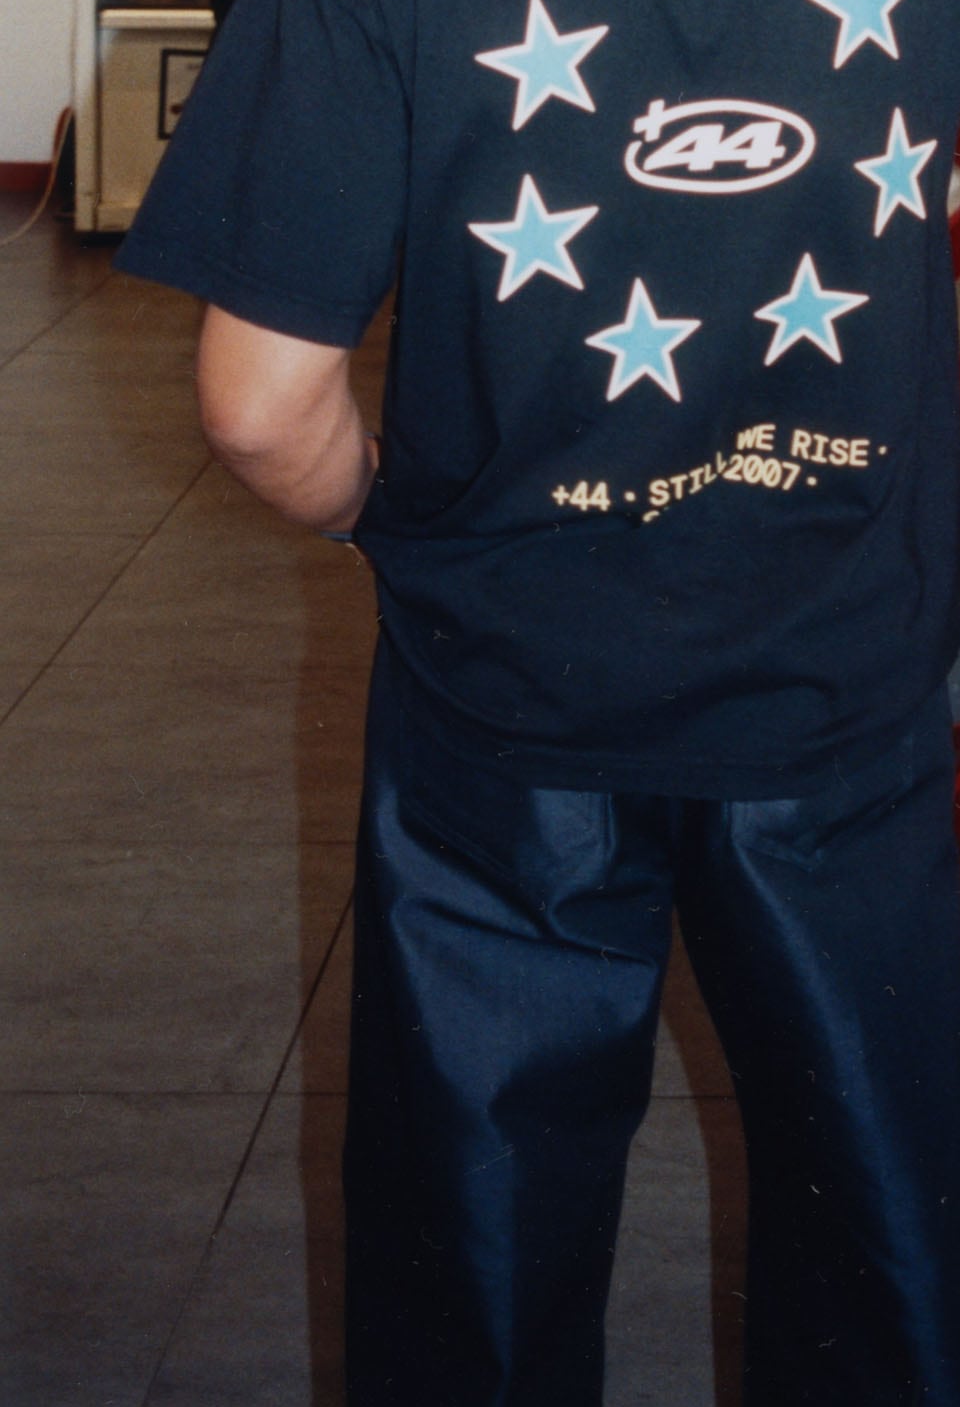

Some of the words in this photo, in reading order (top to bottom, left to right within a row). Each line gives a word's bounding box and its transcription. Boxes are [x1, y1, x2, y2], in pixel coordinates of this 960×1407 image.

[552, 480, 611, 512] +44
[737, 424, 776, 451] WE
[791, 429, 870, 467] RISE
[723, 454, 801, 491] 2007
